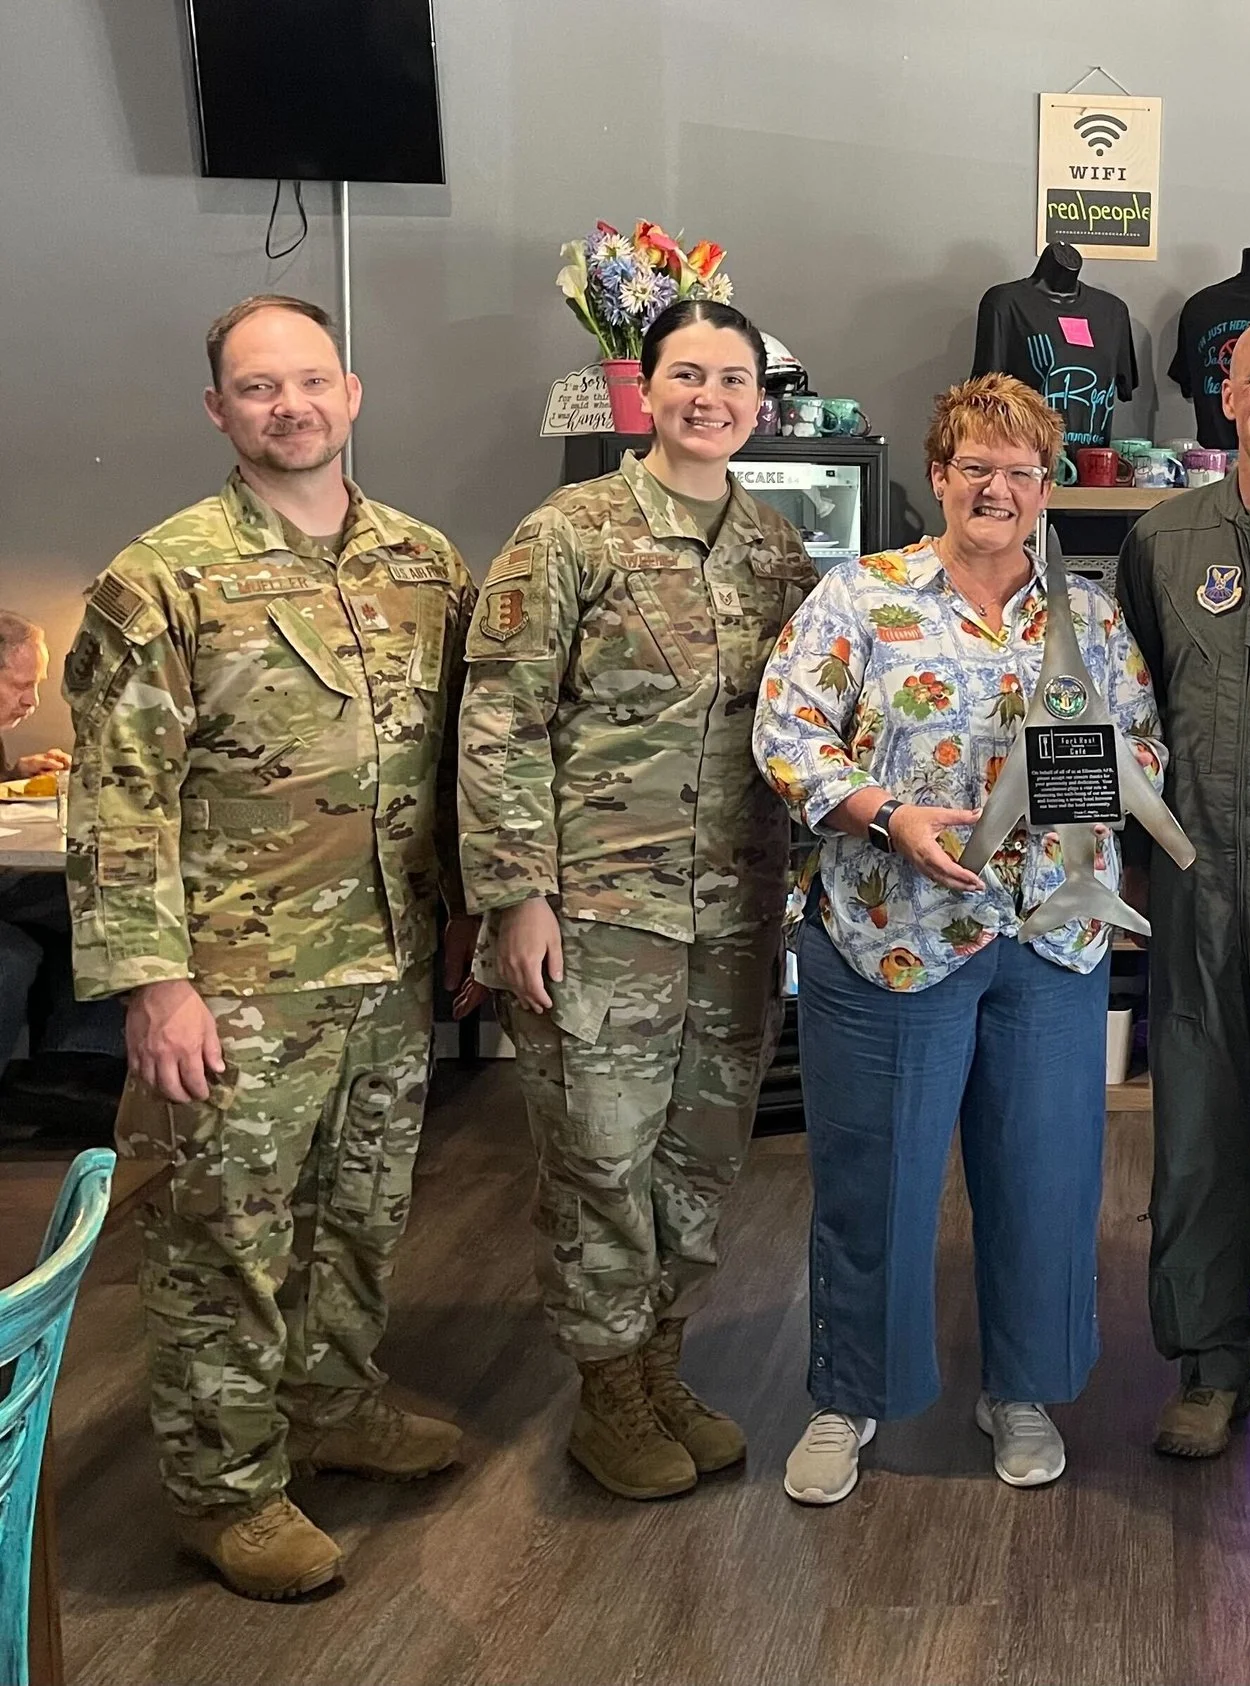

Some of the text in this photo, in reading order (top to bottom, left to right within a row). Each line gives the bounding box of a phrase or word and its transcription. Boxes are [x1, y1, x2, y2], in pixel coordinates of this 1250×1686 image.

[1069, 165, 1127, 181] WIFI
[1207, 322, 1228, 341] JUST
[563, 376, 608, 393] I'm sorr
[558, 394, 572, 402] for
[736, 471, 784, 483] ECAKE
